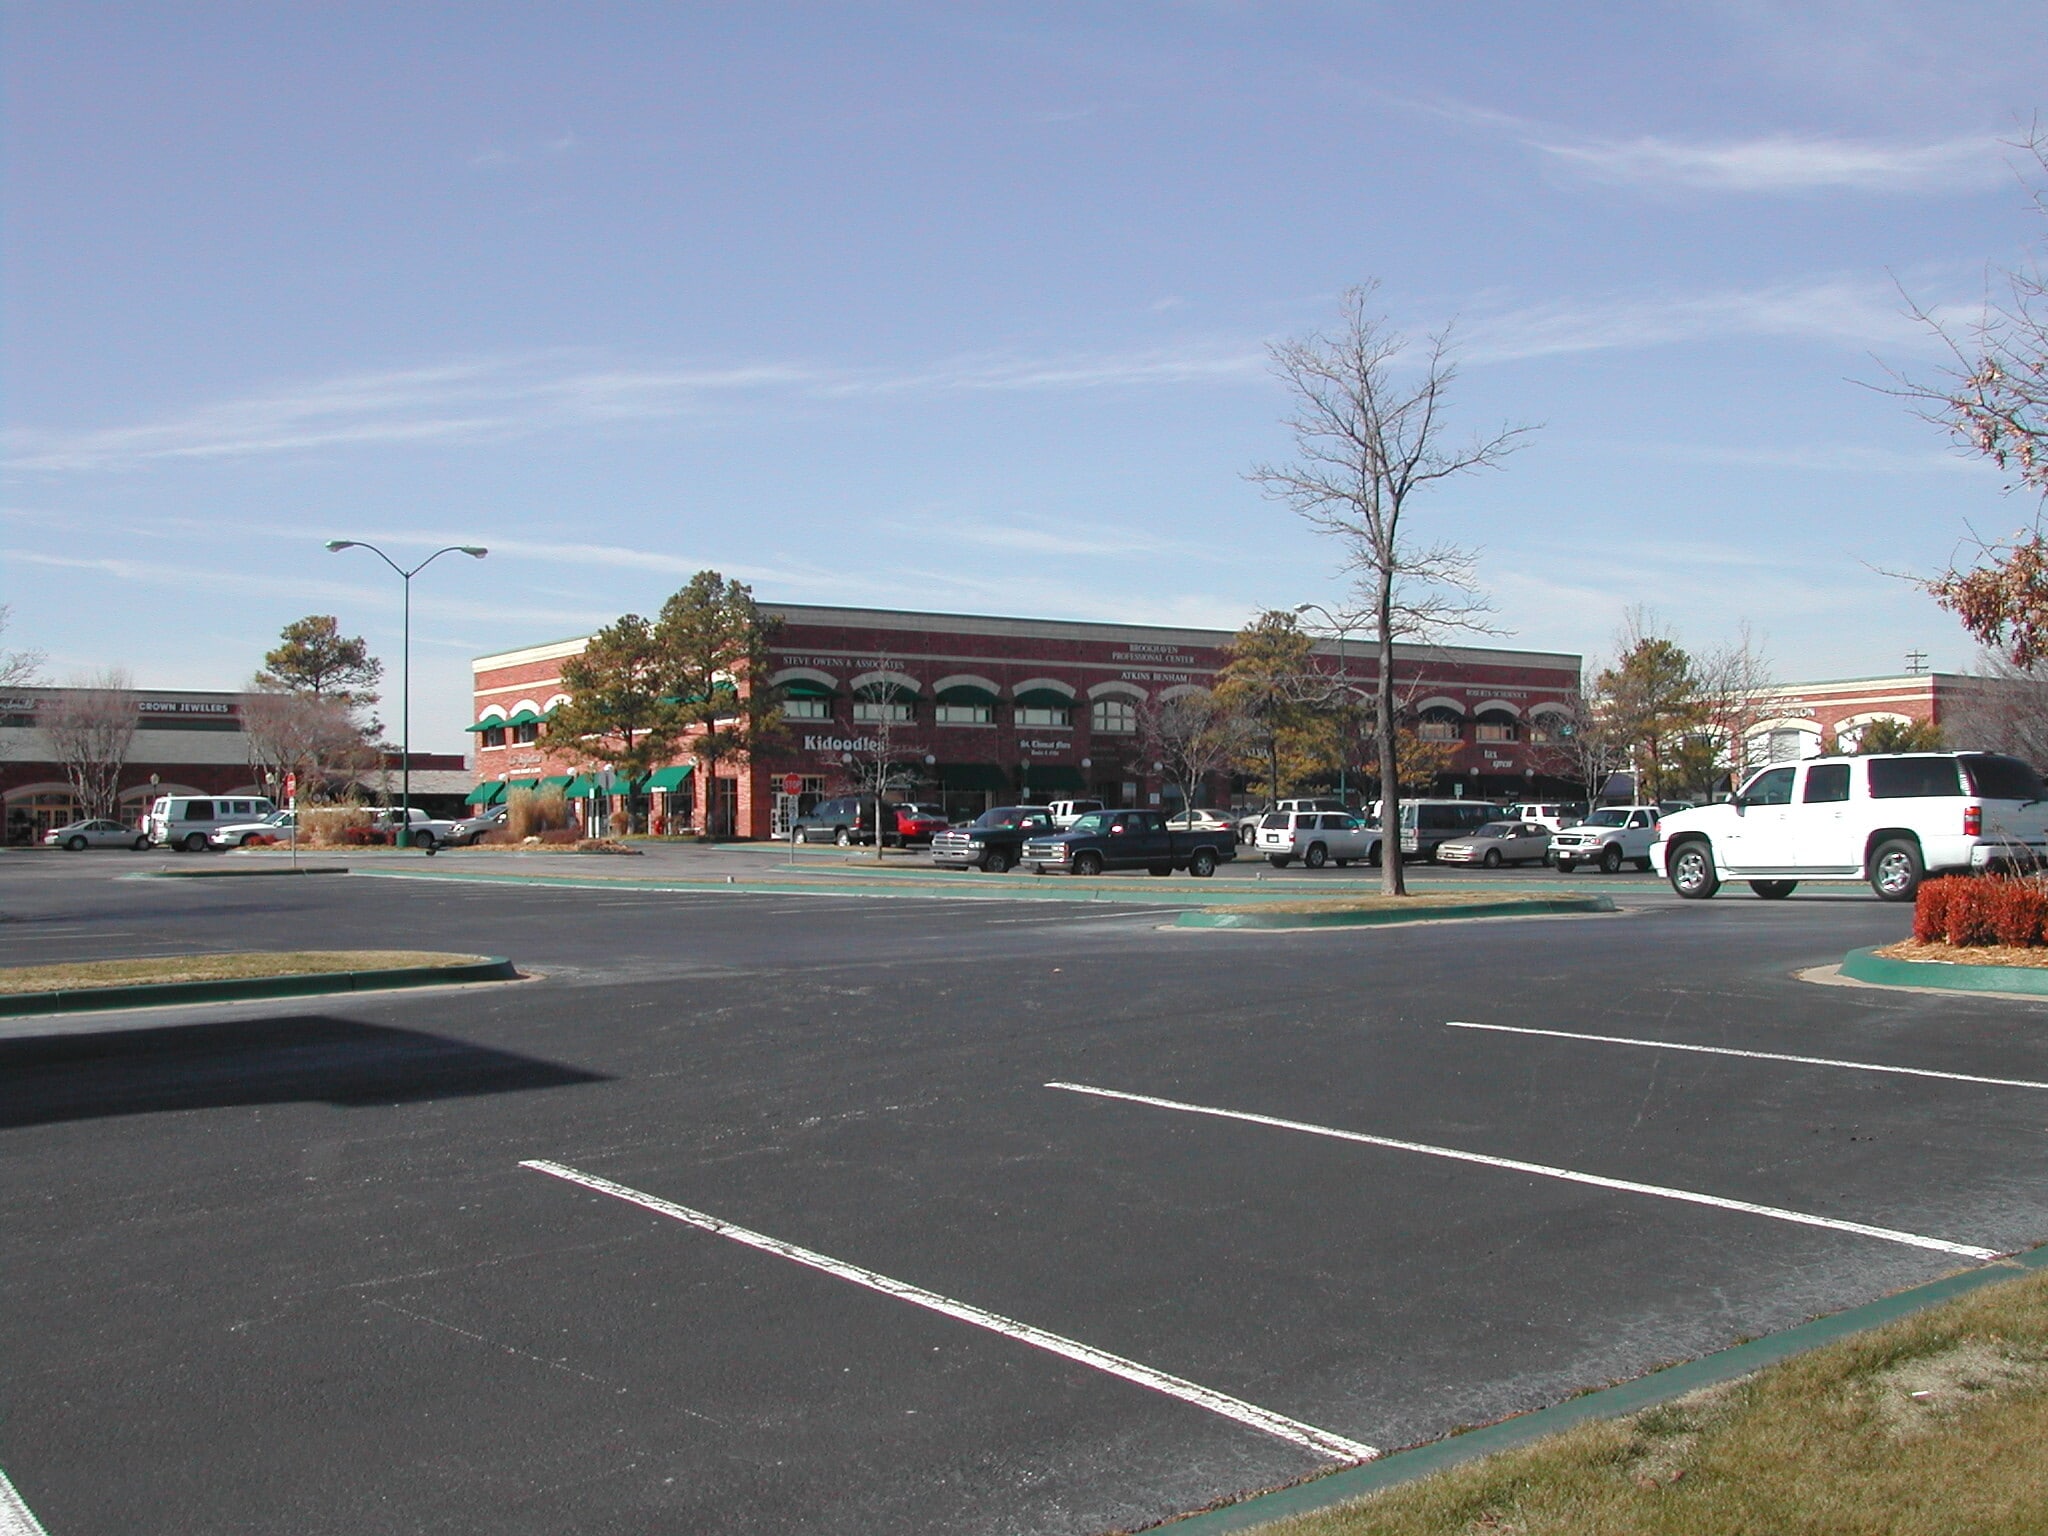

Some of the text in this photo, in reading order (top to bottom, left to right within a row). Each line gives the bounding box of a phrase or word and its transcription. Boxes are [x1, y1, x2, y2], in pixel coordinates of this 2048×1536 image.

[1129, 644, 1178, 653] BROOKHAVEN
[783, 656, 905, 669] STEVE OWENS & ASSOCIATES
[1112, 651, 1194, 664] PROFESSIONAL CENTER
[1121, 672, 1187, 682] ATKINS BENHAM
[139, 702, 228, 713] CROWN JEWELERS
[1781, 707, 1816, 717] SALON
[784, 780, 801, 789] STOP
